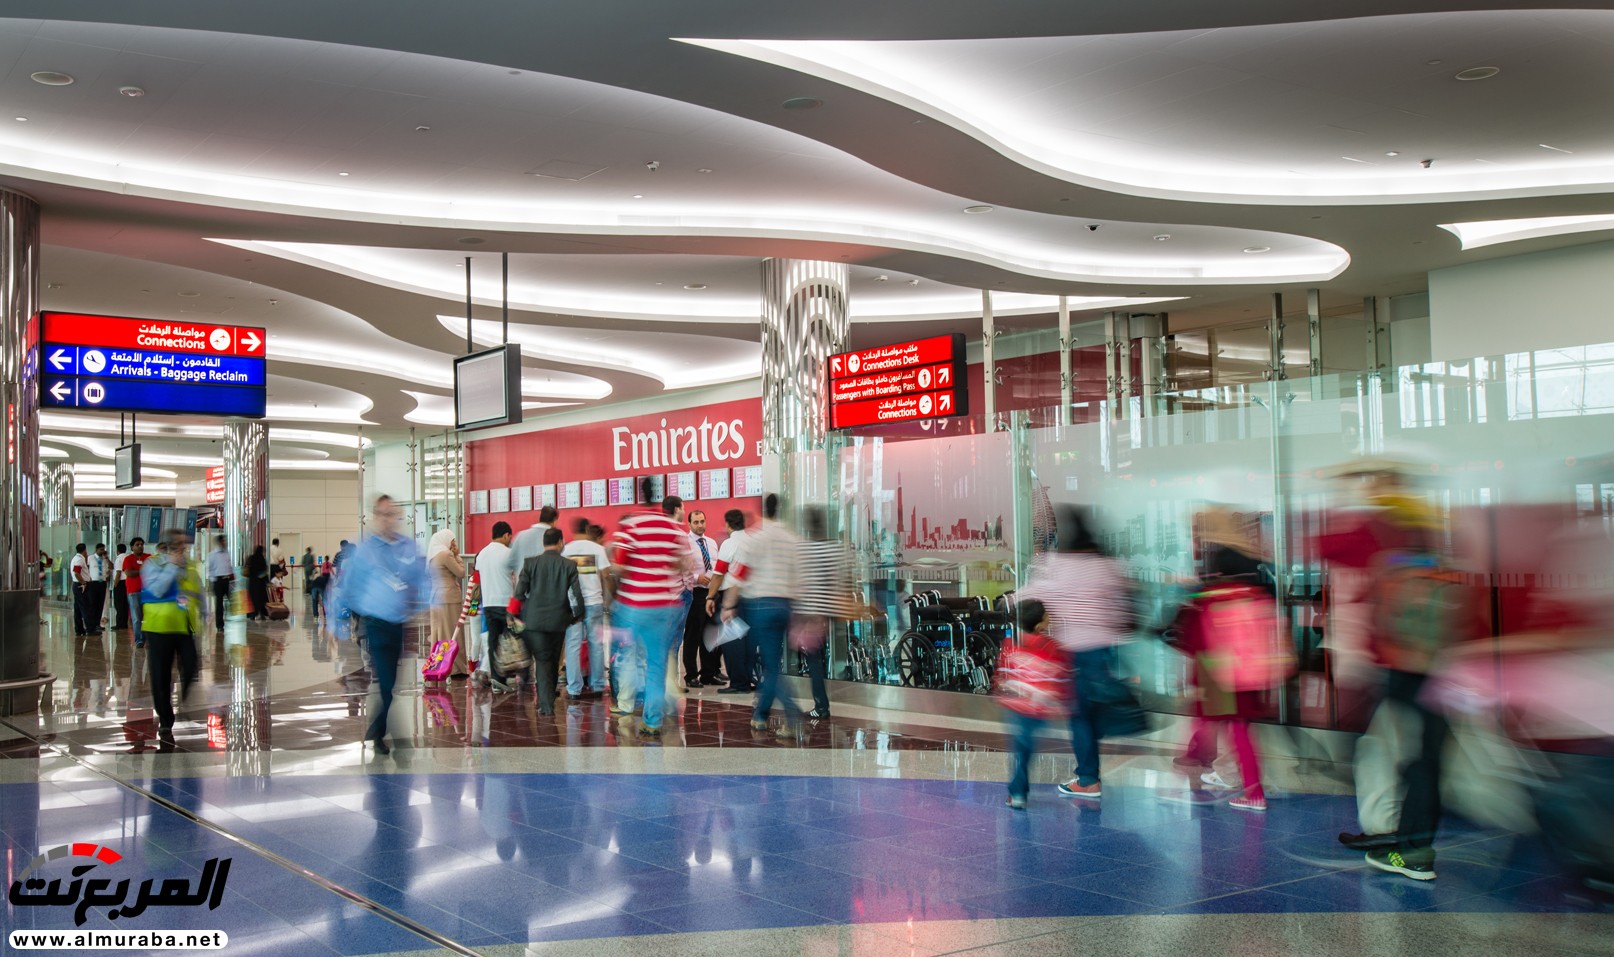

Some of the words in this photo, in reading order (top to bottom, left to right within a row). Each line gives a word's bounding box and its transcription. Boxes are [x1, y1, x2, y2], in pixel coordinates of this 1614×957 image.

[139, 325, 170, 335] الرحلات
[173, 327, 205, 338] مواصلة
[137, 335, 205, 349] Connections
[144, 355, 174, 368] إستلام
[183, 357, 220, 367] القادمون
[863, 358, 901, 371] Connections
[903, 354, 919, 365] Desk
[111, 364, 151, 376] Arrivals
[160, 367, 206, 381] Baggage
[209, 370, 248, 382] Reclaim
[833, 390, 861, 400] Passengers
[862, 387, 874, 396] with
[876, 384, 902, 394] Boarding
[878, 408, 917, 419] Connections
[612, 416, 744, 471] Emirates
